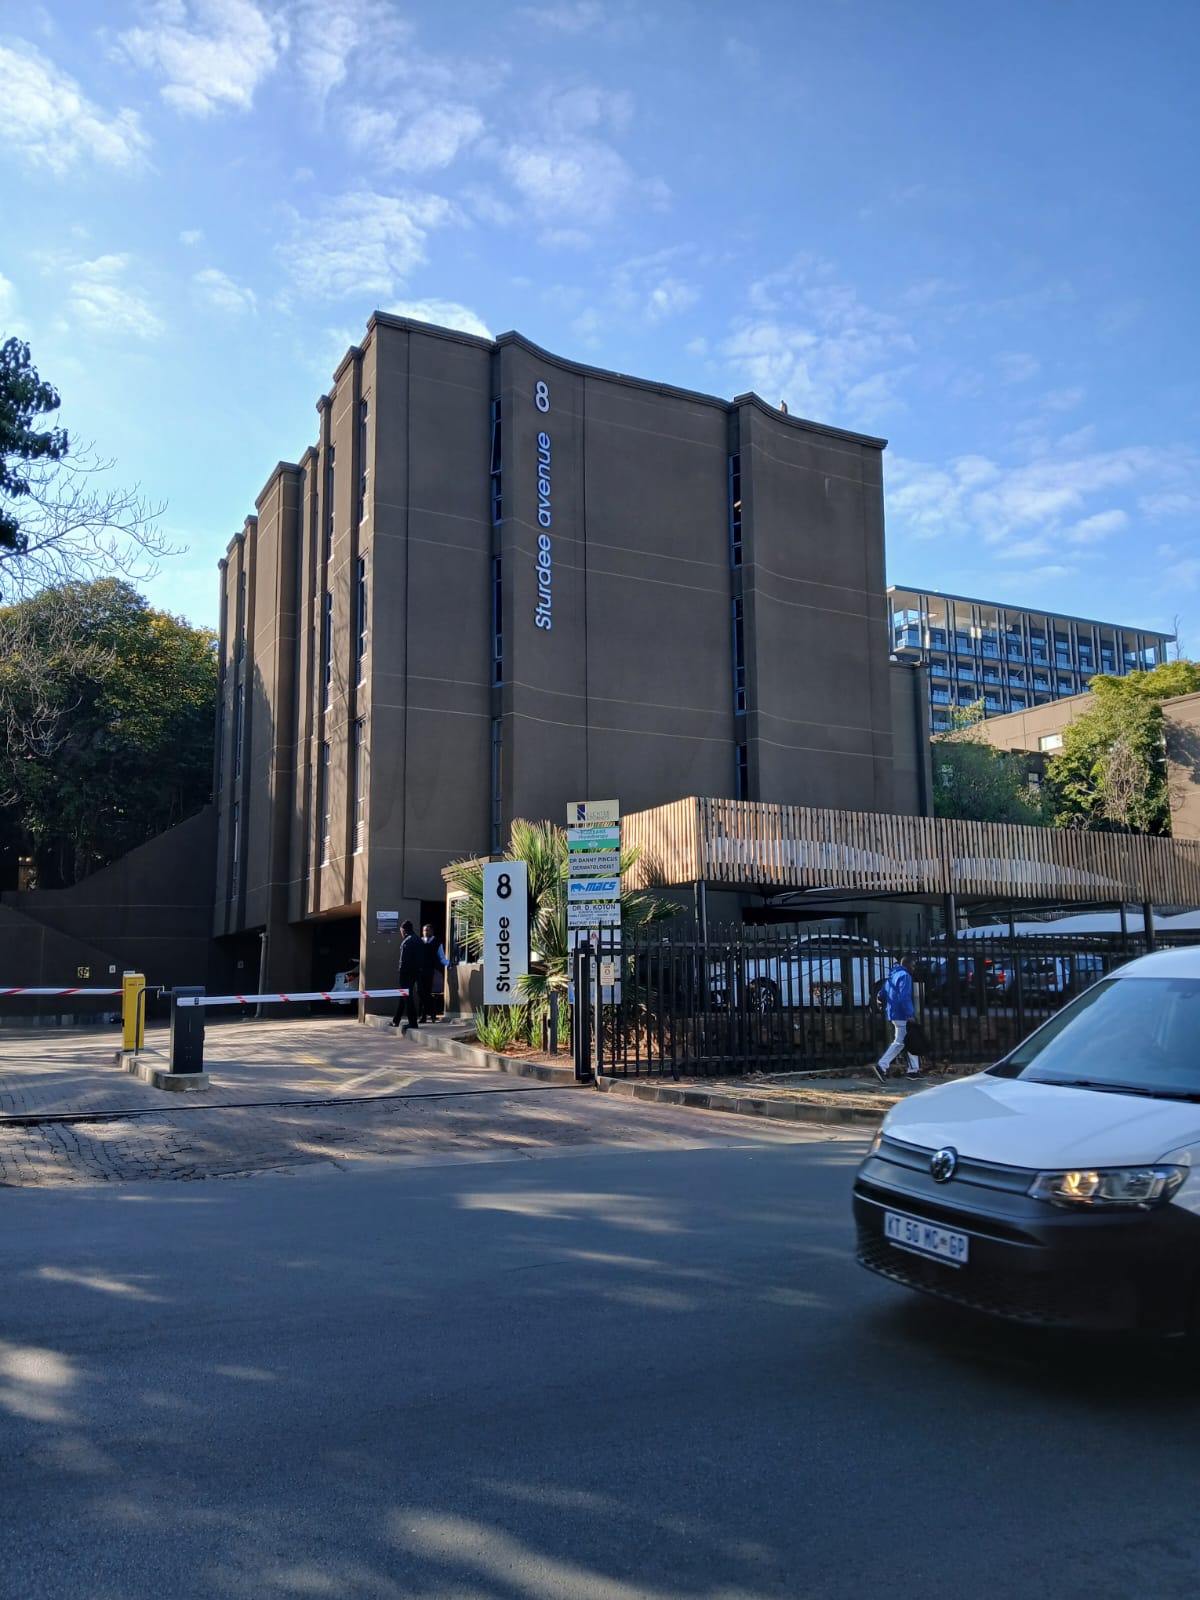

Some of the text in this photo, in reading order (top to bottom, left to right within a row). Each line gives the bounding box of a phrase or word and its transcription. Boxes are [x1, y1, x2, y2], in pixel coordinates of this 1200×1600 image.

[535, 380, 550, 413] 8
[535, 431, 551, 630] Sturdee avenue
[496, 873, 512, 899] 8
[496, 916, 511, 992] Sturdee
